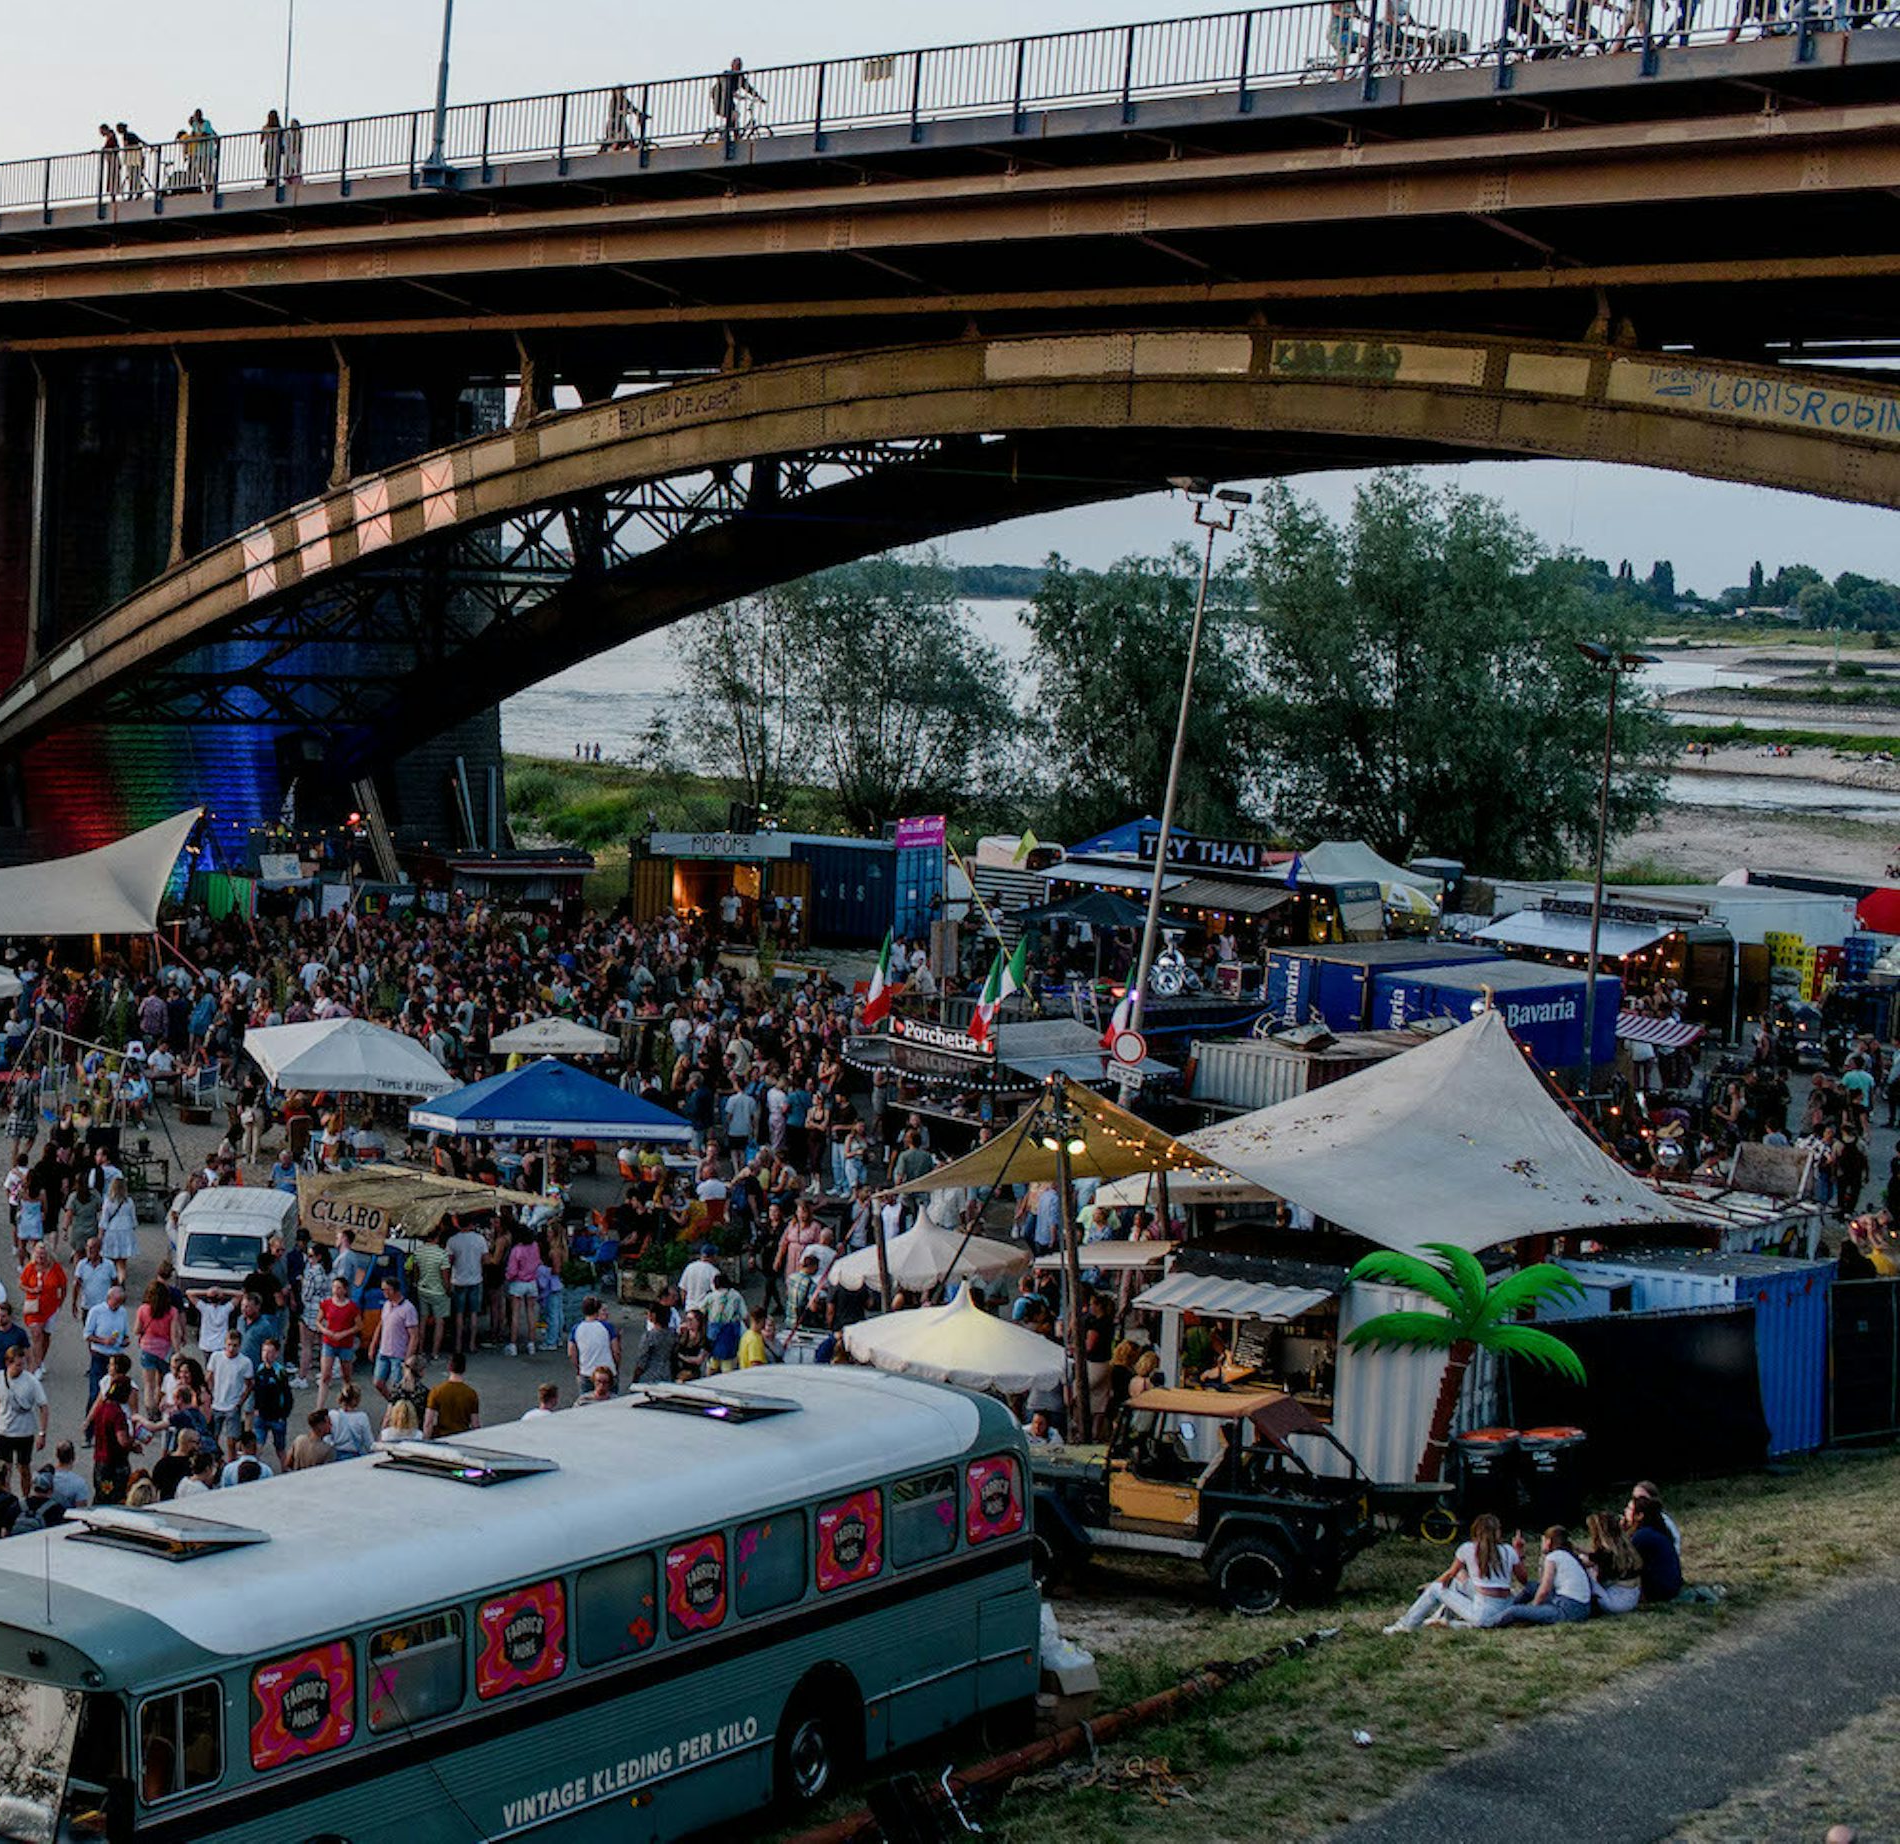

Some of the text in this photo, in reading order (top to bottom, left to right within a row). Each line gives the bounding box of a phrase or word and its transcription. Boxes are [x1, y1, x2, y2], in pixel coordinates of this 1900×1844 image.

[1197, 840, 1255, 866] THAI
[1283, 958, 1300, 1027] Bavaria
[1507, 997, 1576, 1028] Bavaria
[904, 1020, 978, 1052] Porchetta
[312, 1200, 381, 1230] CLARO
[503, 1715, 758, 1828] VINTAGE KLEDING PER KILO
